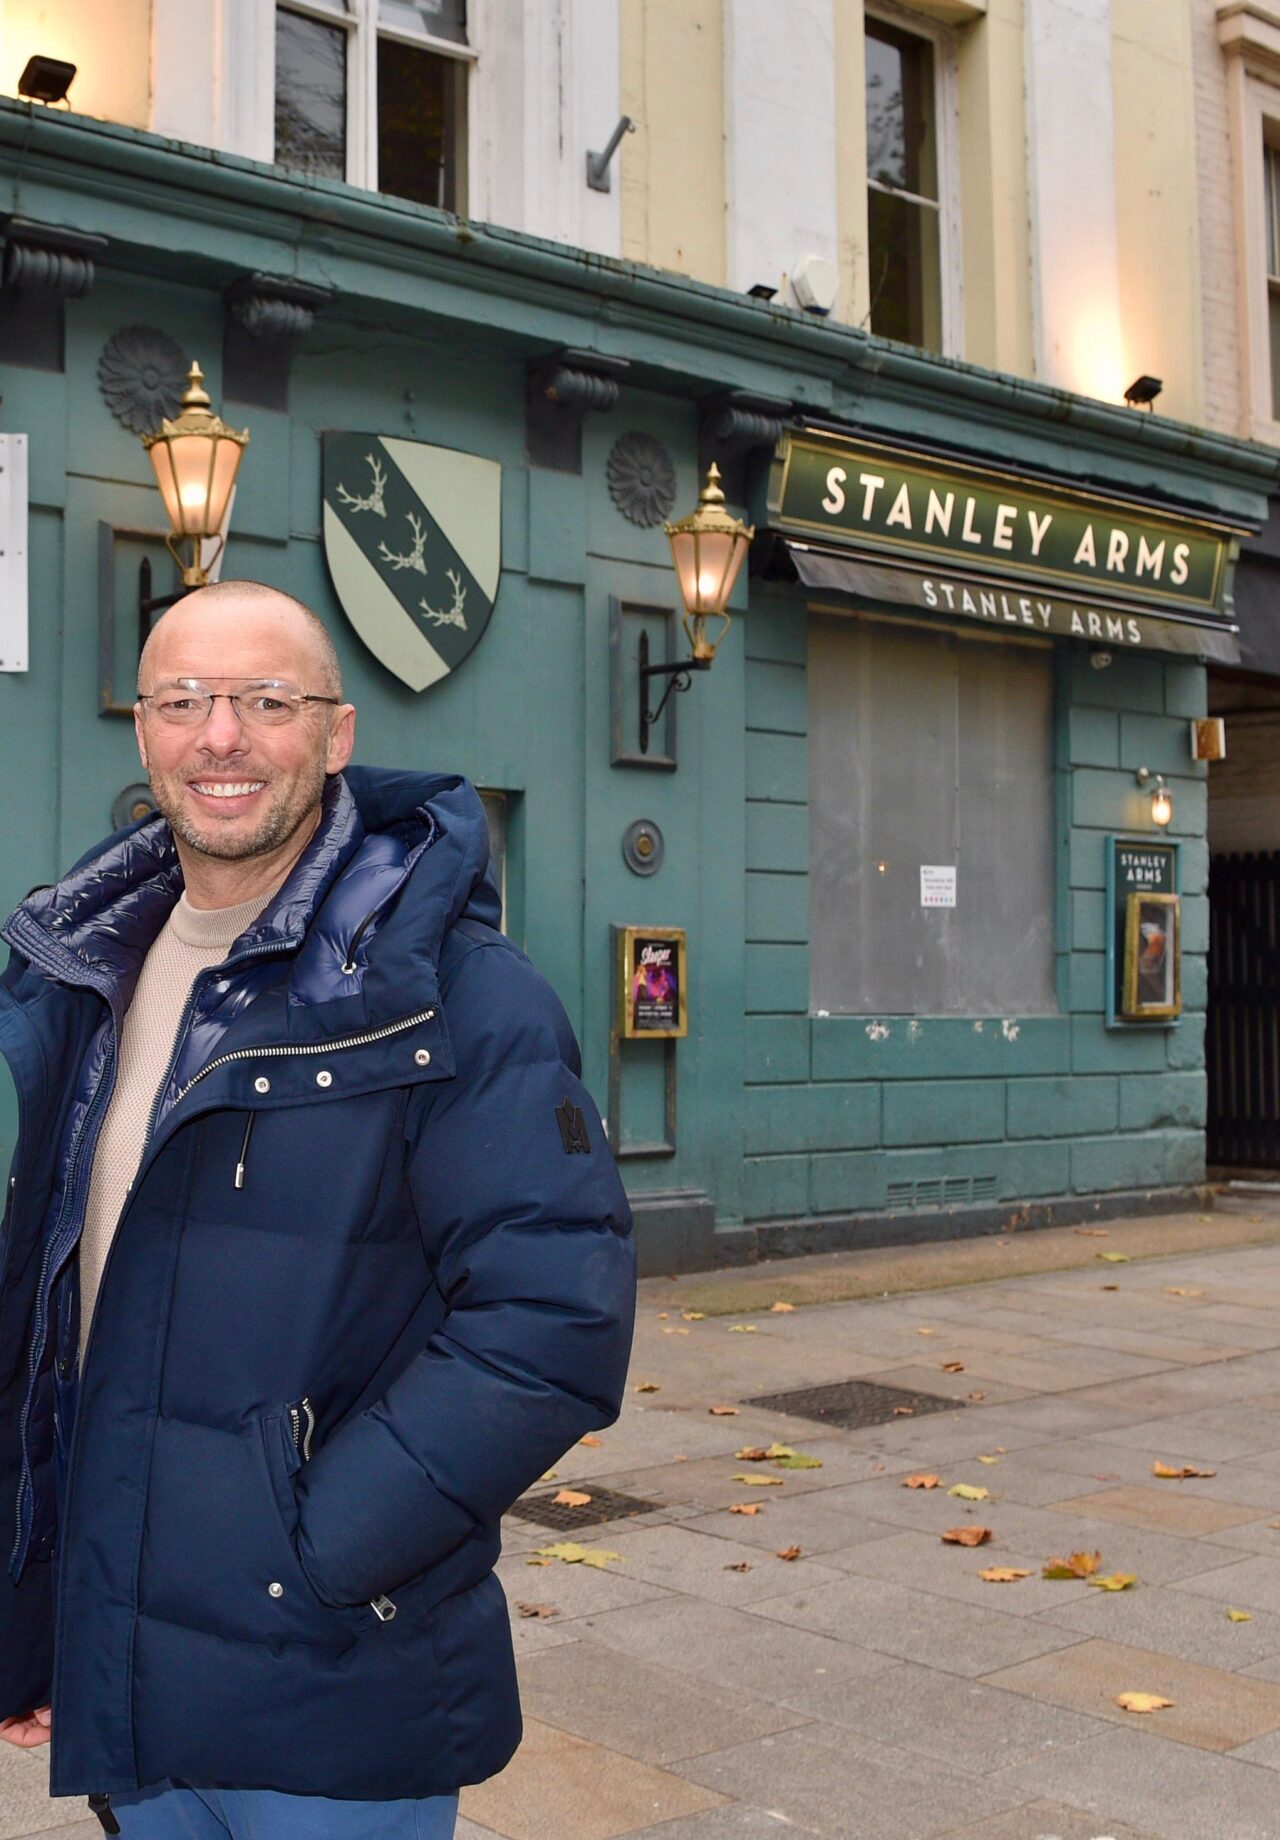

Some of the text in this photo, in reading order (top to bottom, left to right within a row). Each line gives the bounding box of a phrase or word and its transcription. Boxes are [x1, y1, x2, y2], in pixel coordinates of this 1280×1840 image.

[821, 466, 1191, 585] STANLEY ARMS
[923, 581, 1142, 645] STANLEY ARMS
[1120, 853, 1167, 869] STANLEY
[1126, 867, 1162, 884] ARMS
